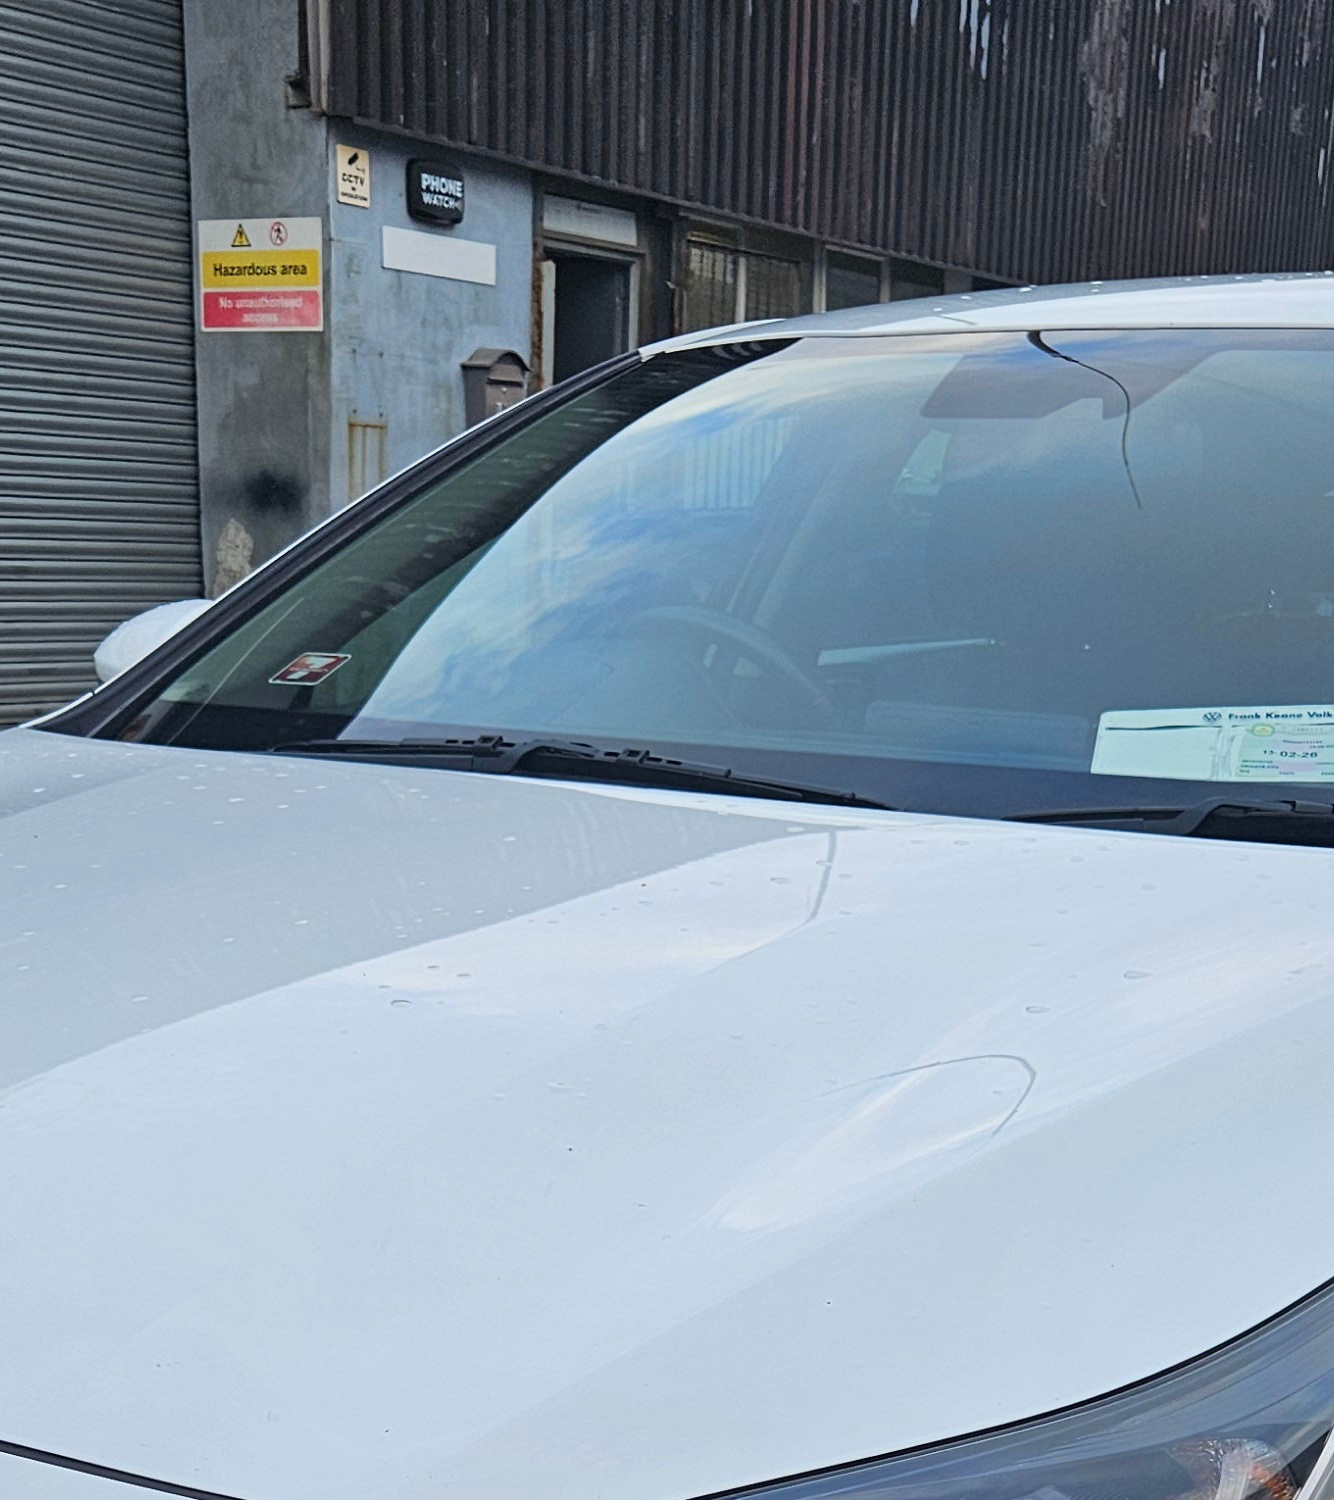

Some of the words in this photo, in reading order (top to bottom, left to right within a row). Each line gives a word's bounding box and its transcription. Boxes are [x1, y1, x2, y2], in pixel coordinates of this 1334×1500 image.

[421, 173, 464, 198] PHONE
[213, 263, 278, 277] Hazardous
[280, 264, 308, 275] area
[218, 297, 234, 309] No
[1228, 711, 1262, 721] Frank
